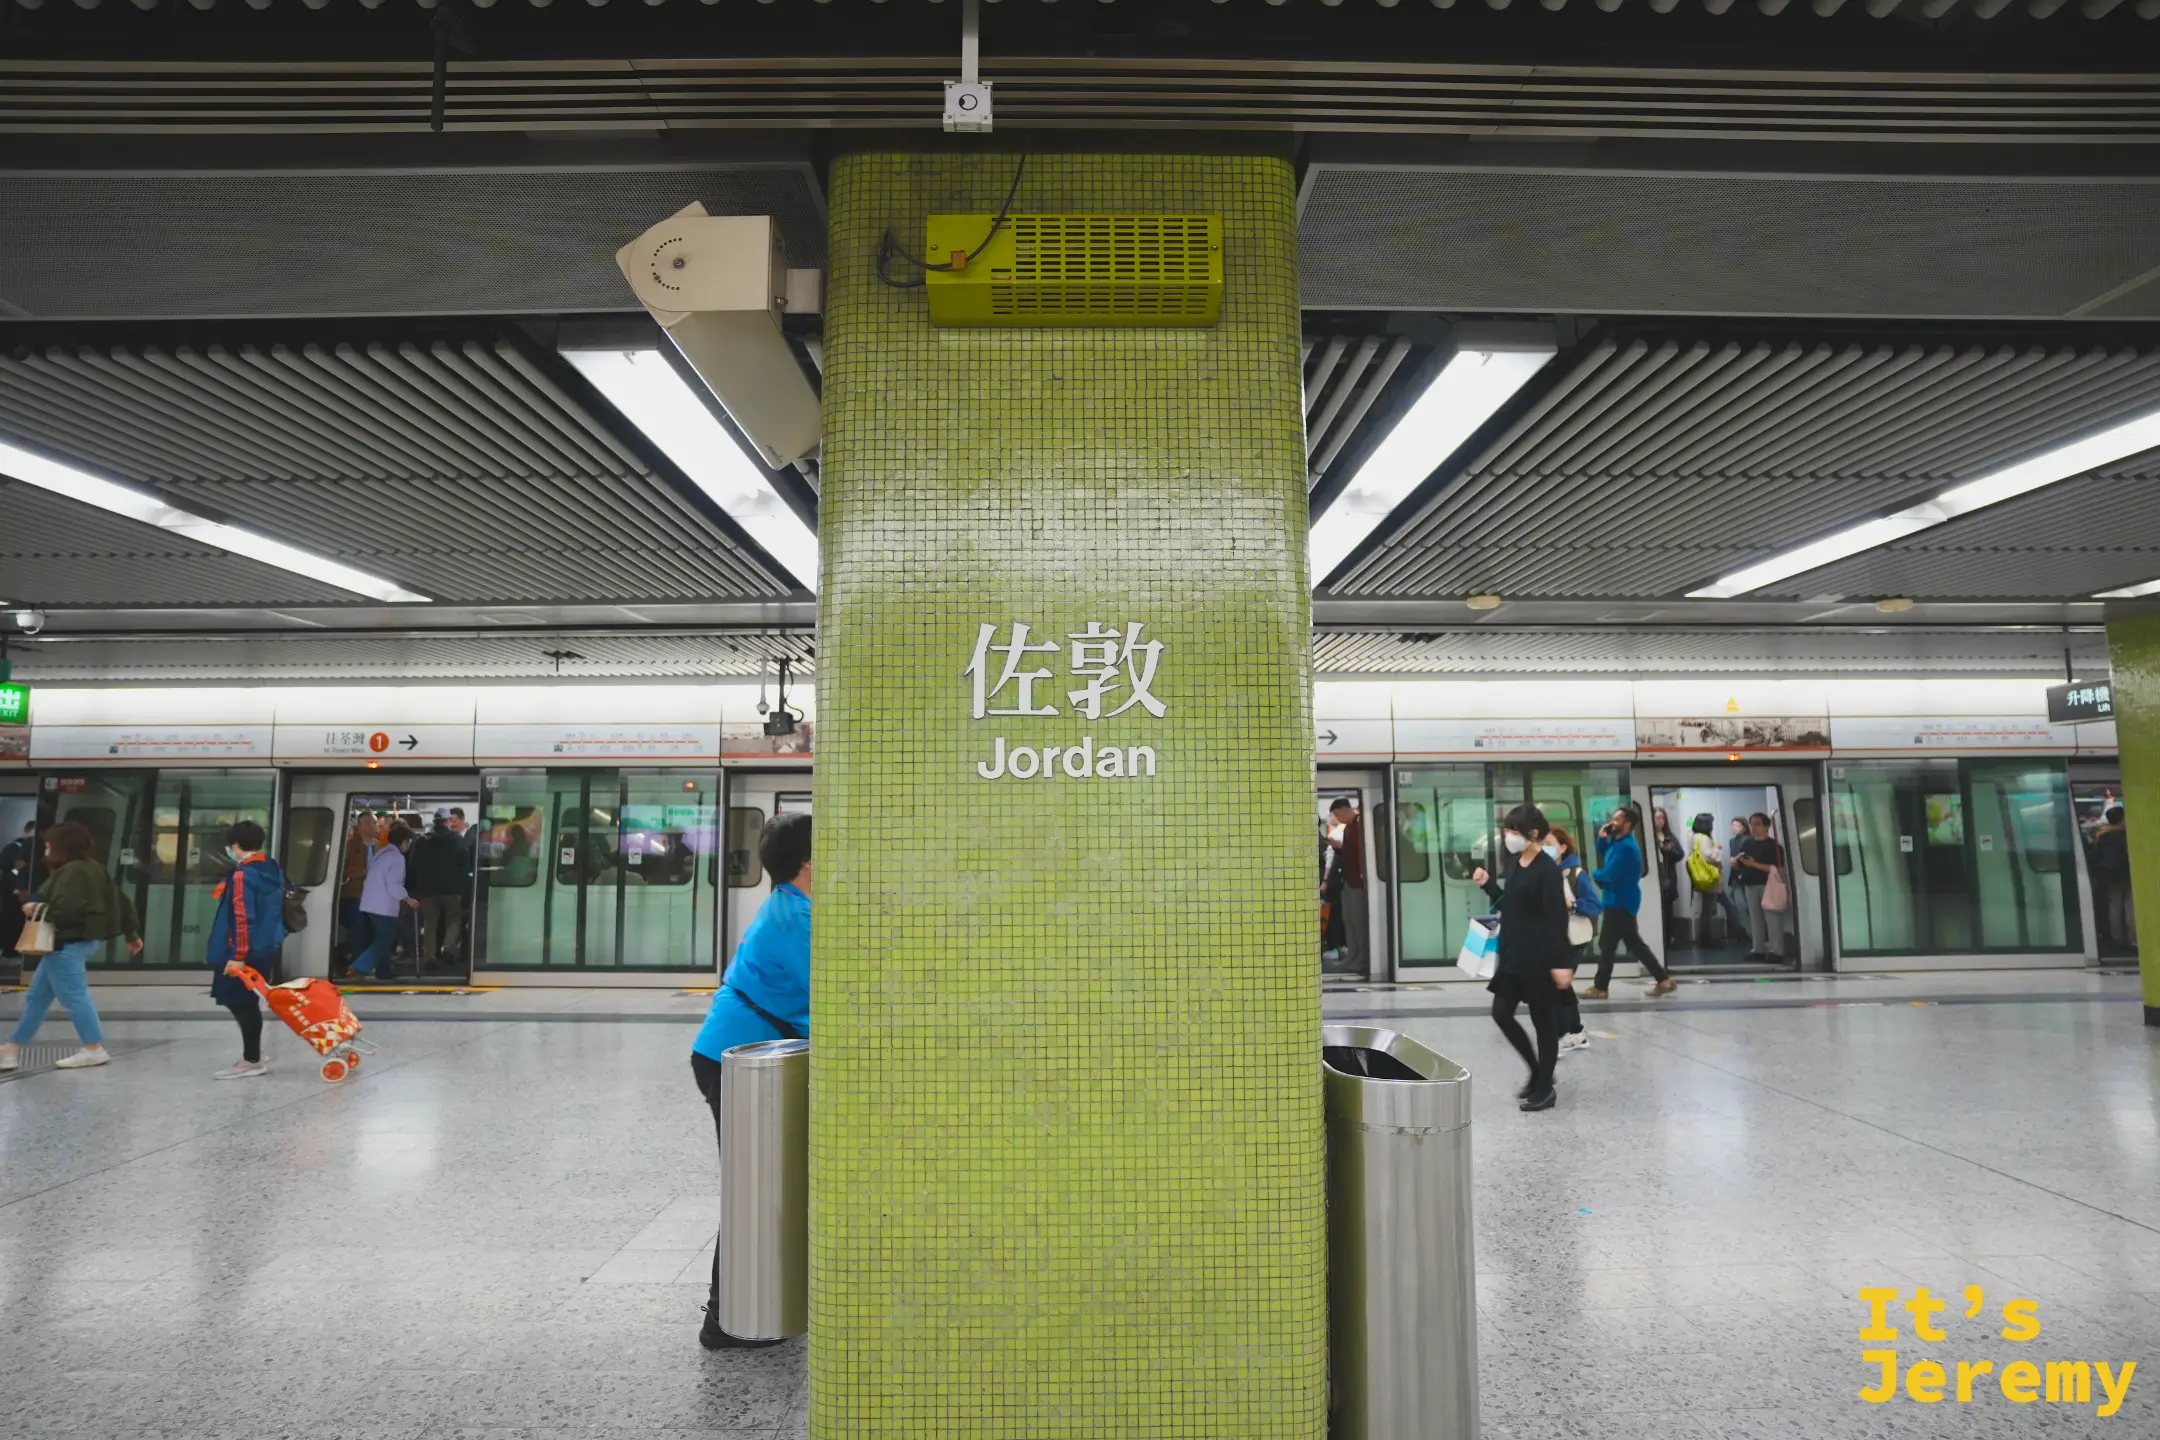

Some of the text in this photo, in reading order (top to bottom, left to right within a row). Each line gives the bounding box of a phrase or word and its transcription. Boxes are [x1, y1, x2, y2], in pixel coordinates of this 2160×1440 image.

[965, 621, 1167, 720] 佐敦
[0, 688, 21, 709] 出
[2066, 686, 2110, 706] 升降機
[977, 736, 1156, 780] Jordan
